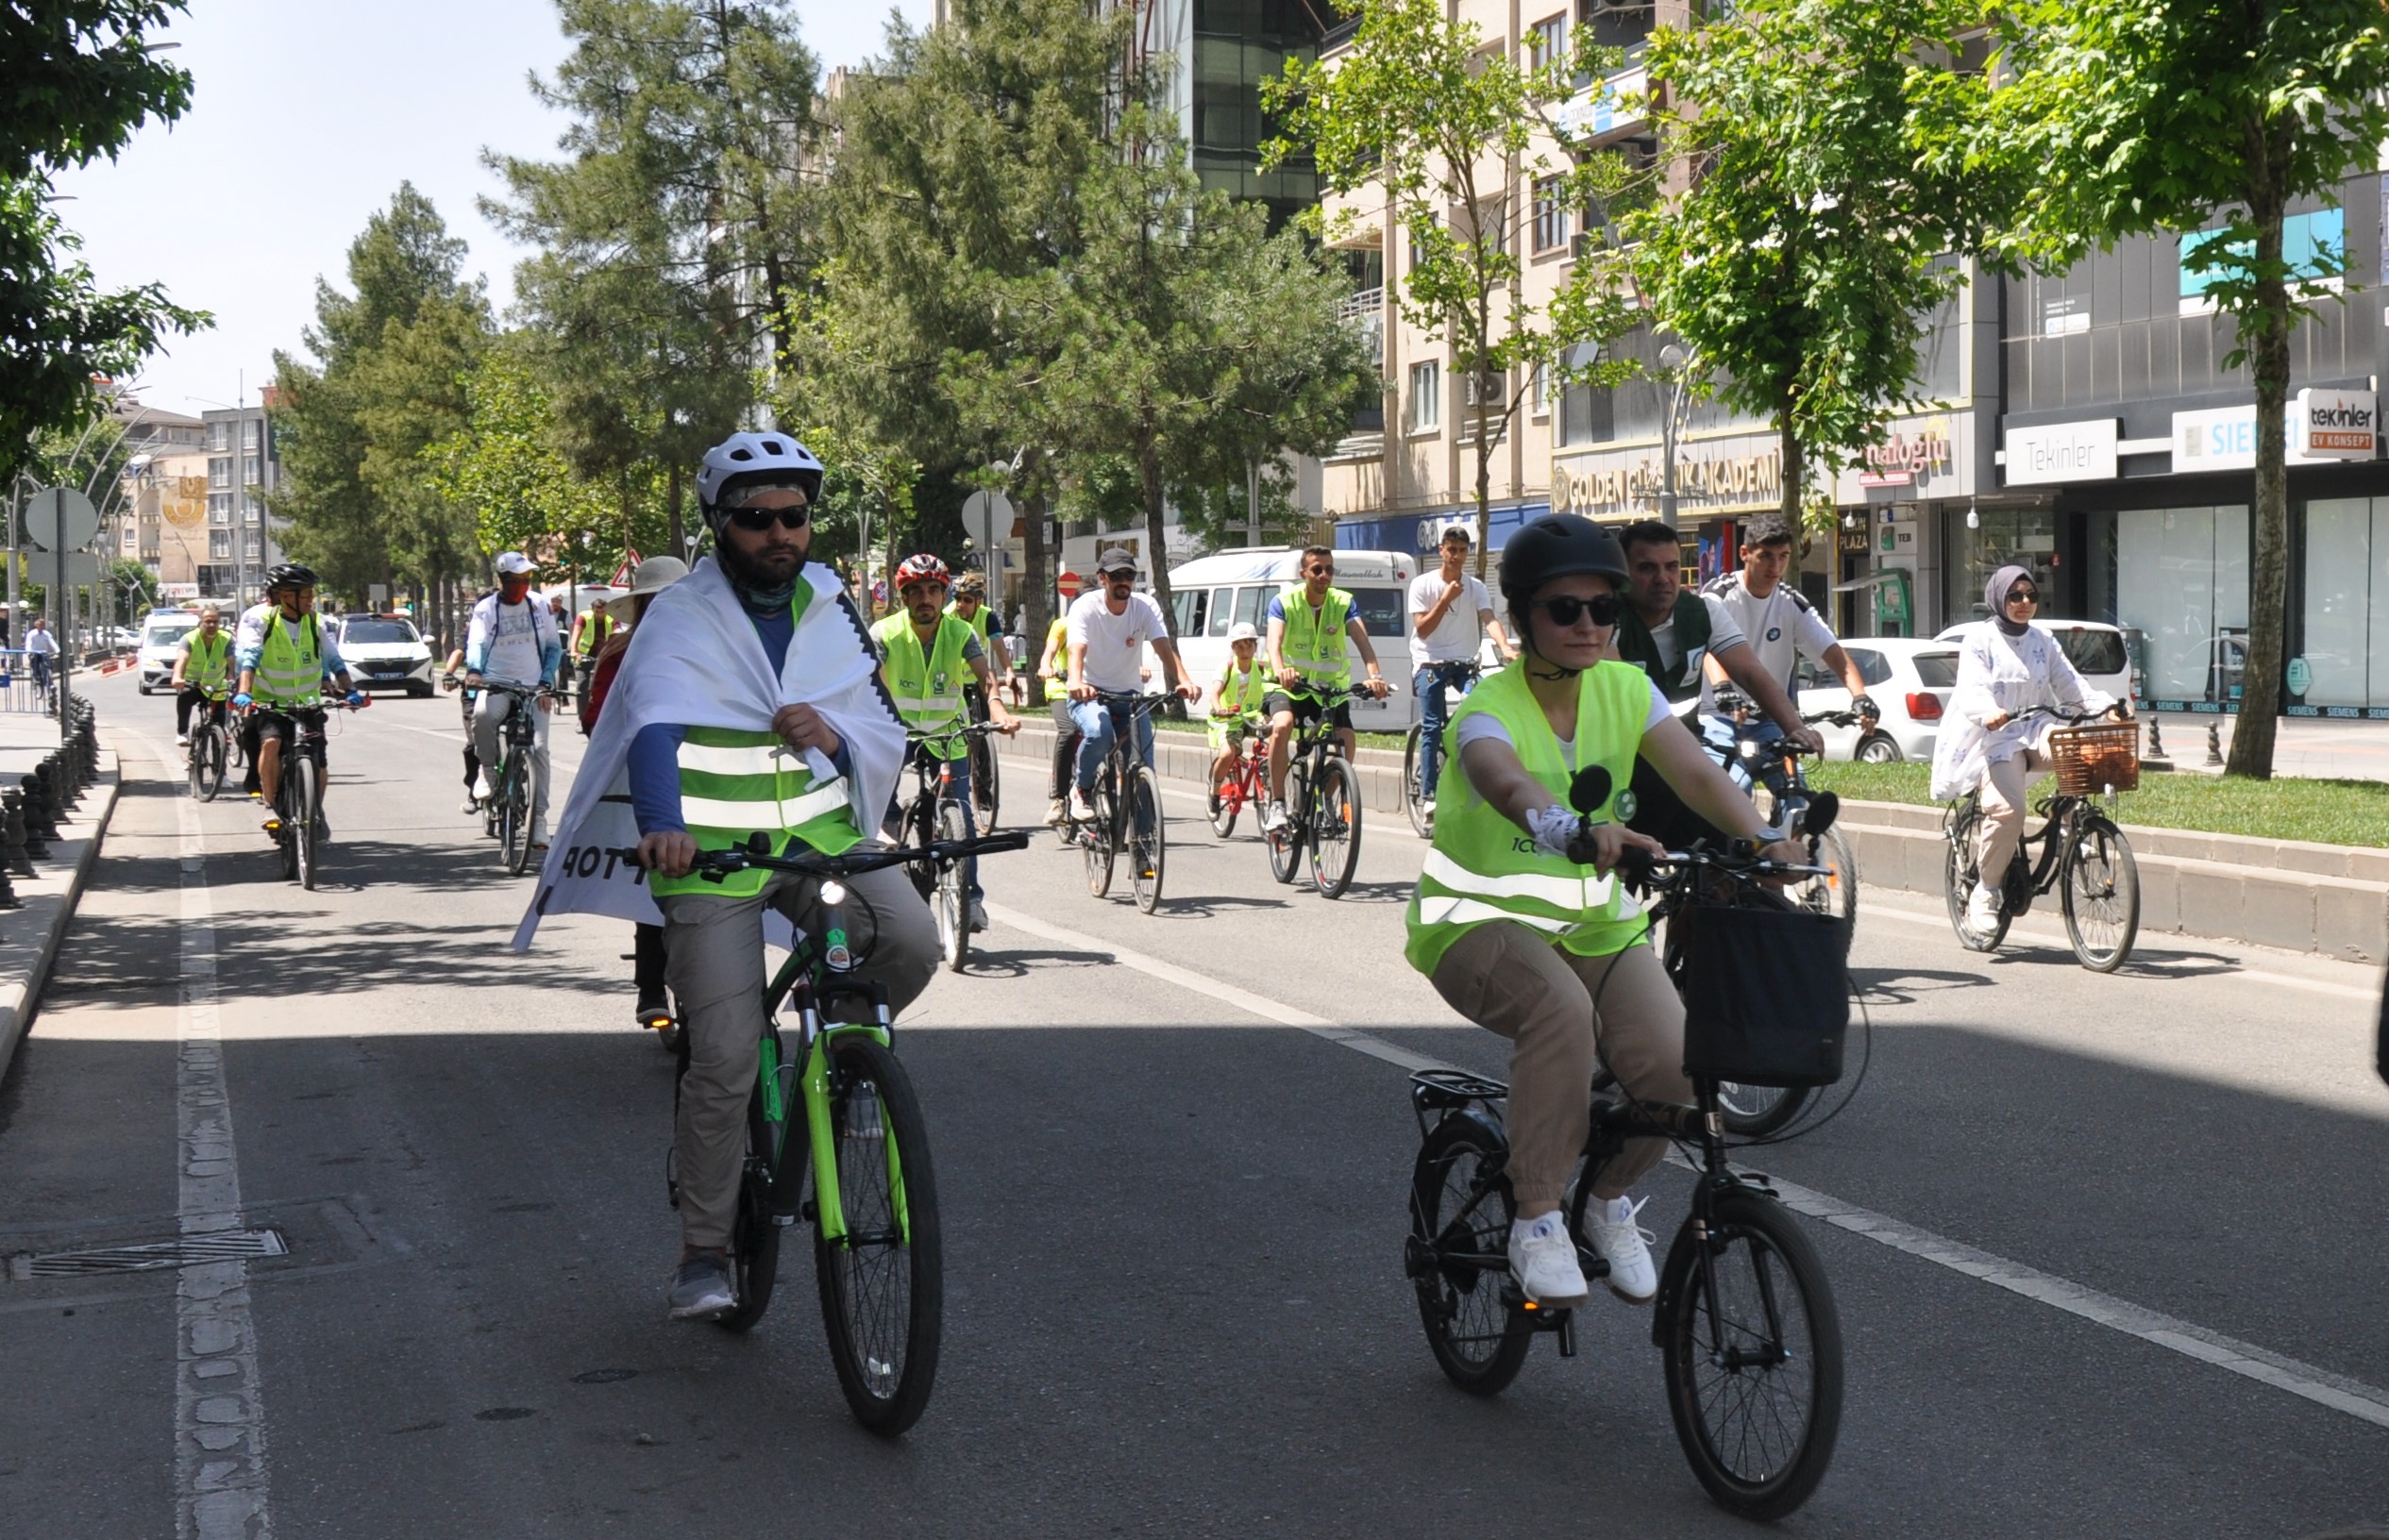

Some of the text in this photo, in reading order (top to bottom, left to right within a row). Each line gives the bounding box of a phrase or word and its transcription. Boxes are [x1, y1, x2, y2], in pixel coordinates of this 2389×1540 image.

[2312, 404, 2372, 427] tekinler
[2312, 434, 2370, 446] EV KONSEPT
[2027, 435, 2095, 471] Tekinler
[1569, 472, 1626, 506] GOLDEN
[1700, 447, 1779, 495] AKADEMİ
[1840, 514, 1866, 532] TKİN
[1839, 534, 1868, 550] PLAZA
[1898, 533, 1911, 542] TEB
[2156, 702, 2184, 711] SIEMENS
[2191, 703, 2220, 712] SIEMENS
[2287, 706, 2318, 716] SIEMENS
[2327, 707, 2359, 717] SIEMENS
